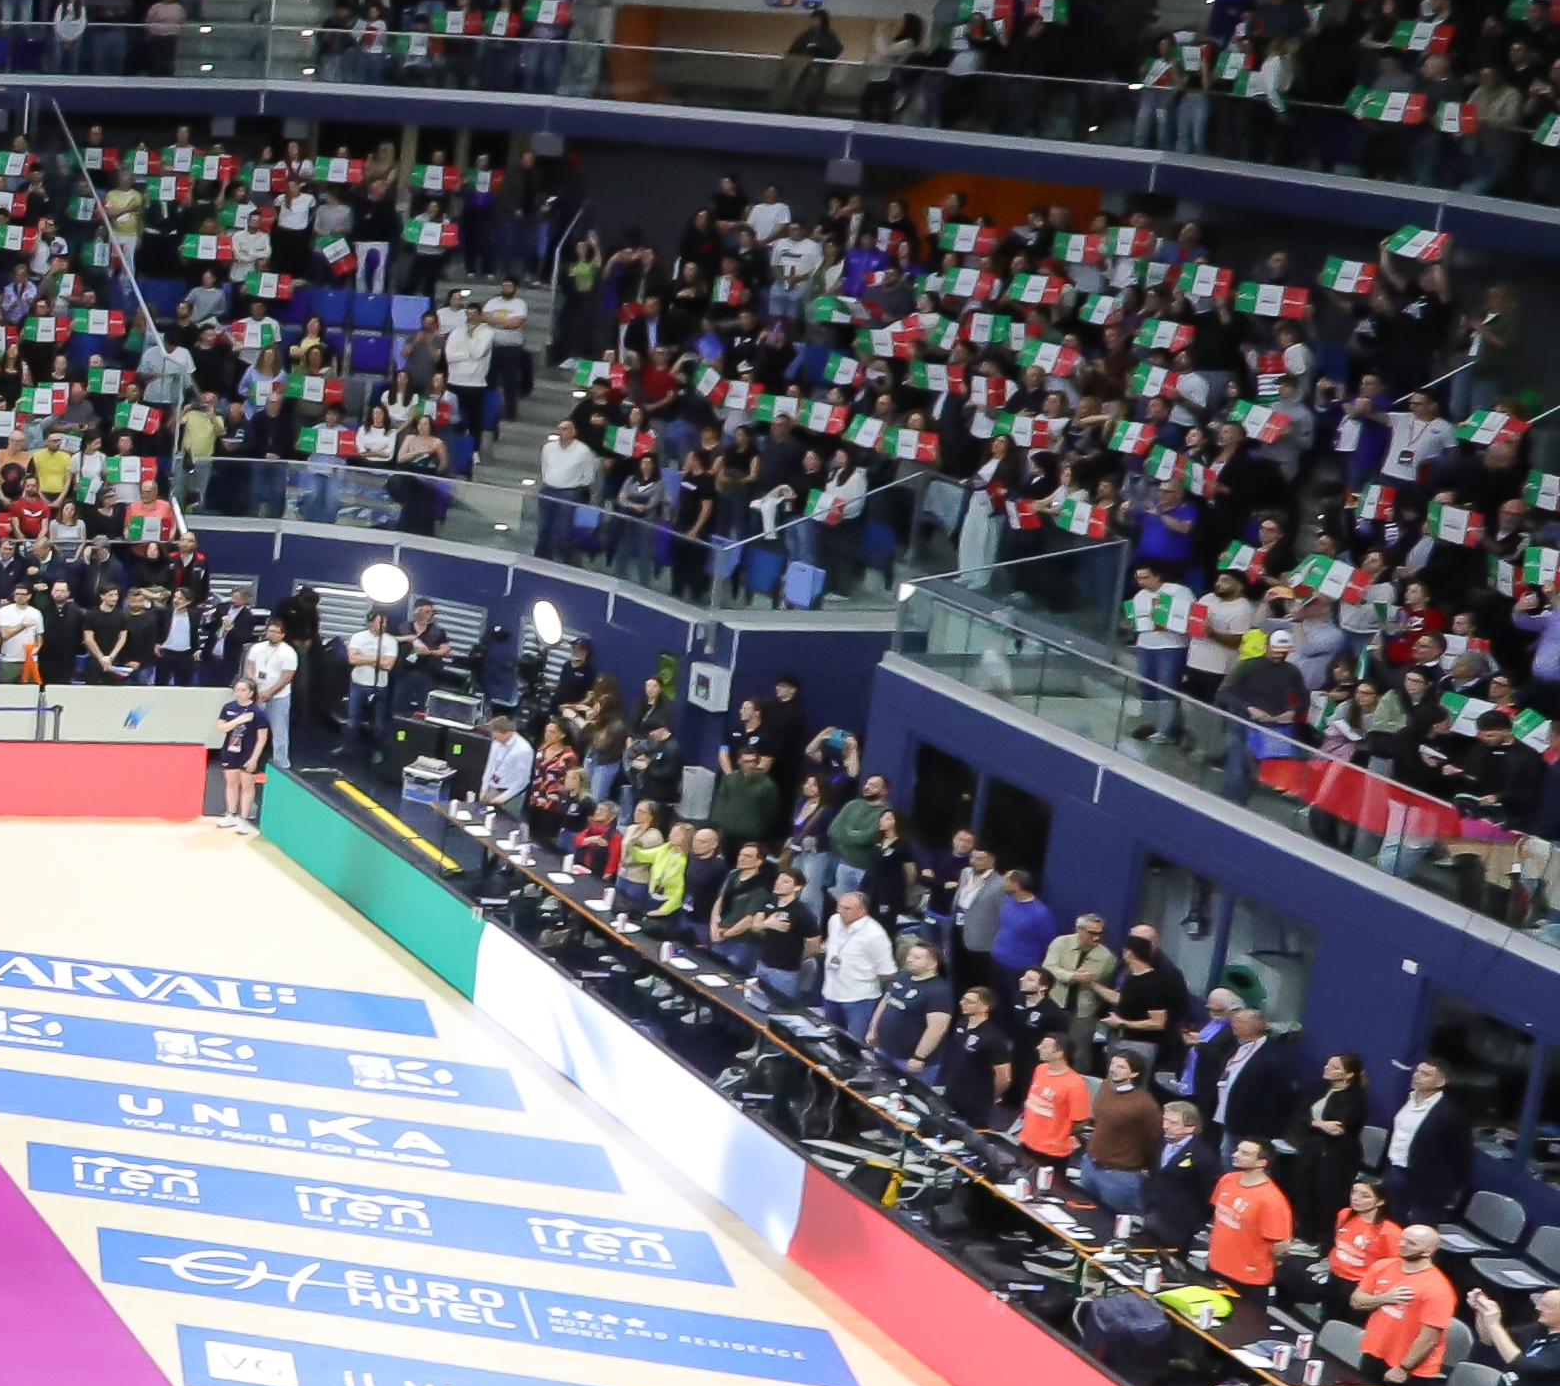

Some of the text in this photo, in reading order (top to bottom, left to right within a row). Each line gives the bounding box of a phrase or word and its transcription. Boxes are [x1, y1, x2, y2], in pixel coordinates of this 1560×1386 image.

[118, 1093, 446, 1155] UNIKA
[72, 1162, 200, 1197] iren
[297, 1191, 431, 1230] iren
[528, 1224, 674, 1264] iren
[344, 1269, 507, 1309] EURO
[347, 1287, 517, 1330] HOTEL
[221, 1351, 285, 1379] VG
